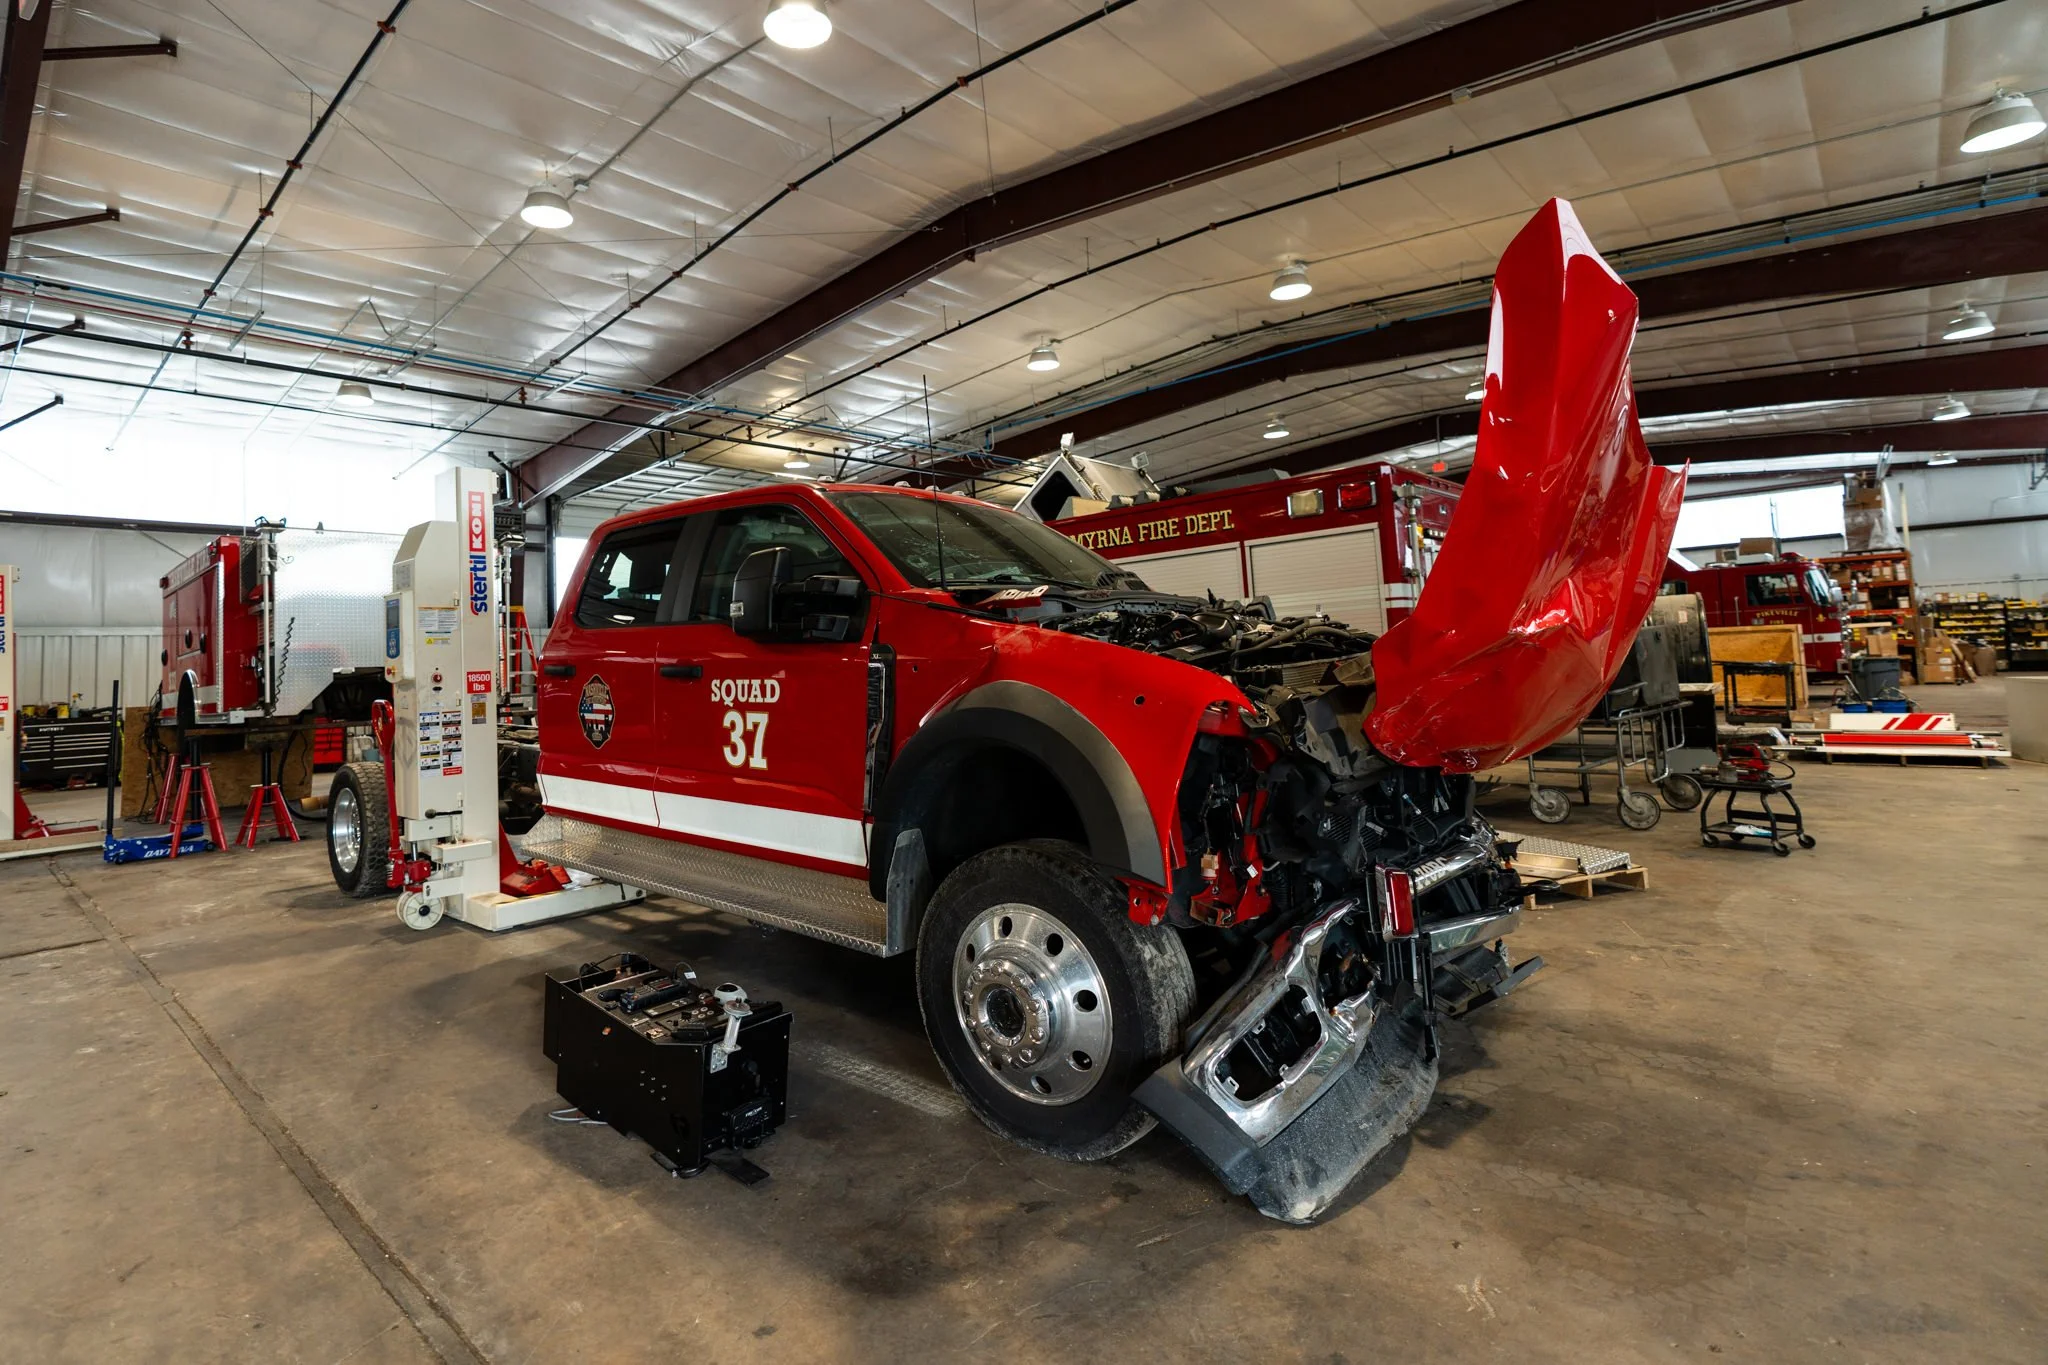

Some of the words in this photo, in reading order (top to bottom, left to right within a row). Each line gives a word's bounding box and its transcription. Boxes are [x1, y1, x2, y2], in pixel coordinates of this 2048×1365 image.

[470, 494, 484, 550] KONI
[1138, 518, 1180, 542] FIRE
[1186, 509, 1235, 535] DEPT.
[469, 555, 488, 616] stertil
[467, 674, 491, 683] 18500
[473, 683, 485, 691] lbs
[711, 678, 781, 707] SQUAD
[722, 709, 770, 770] 37
